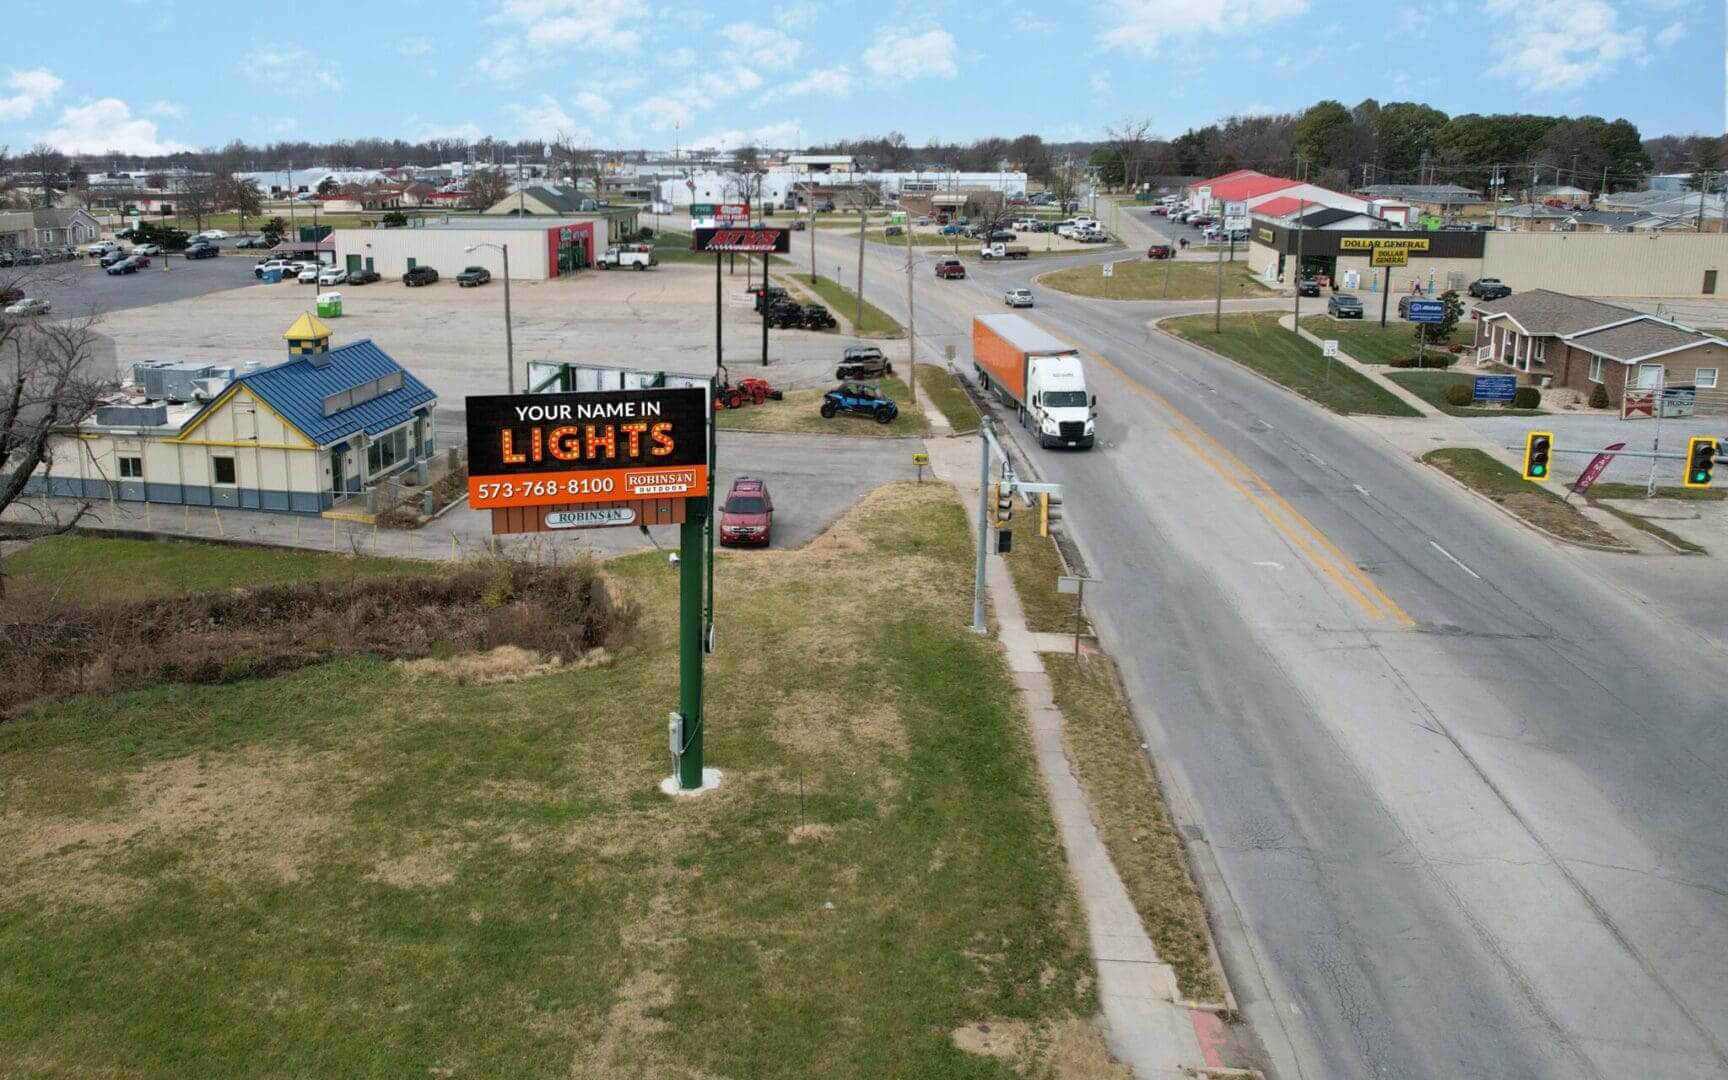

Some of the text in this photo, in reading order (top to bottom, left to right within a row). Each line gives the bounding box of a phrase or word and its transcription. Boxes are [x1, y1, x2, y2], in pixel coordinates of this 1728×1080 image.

[1344, 240, 1426, 249] DOLLAR GENERAL
[515, 401, 661, 421] YOUR NAME IN
[502, 422, 675, 464] LIGHTS
[478, 477, 614, 499] 573-768-8100
